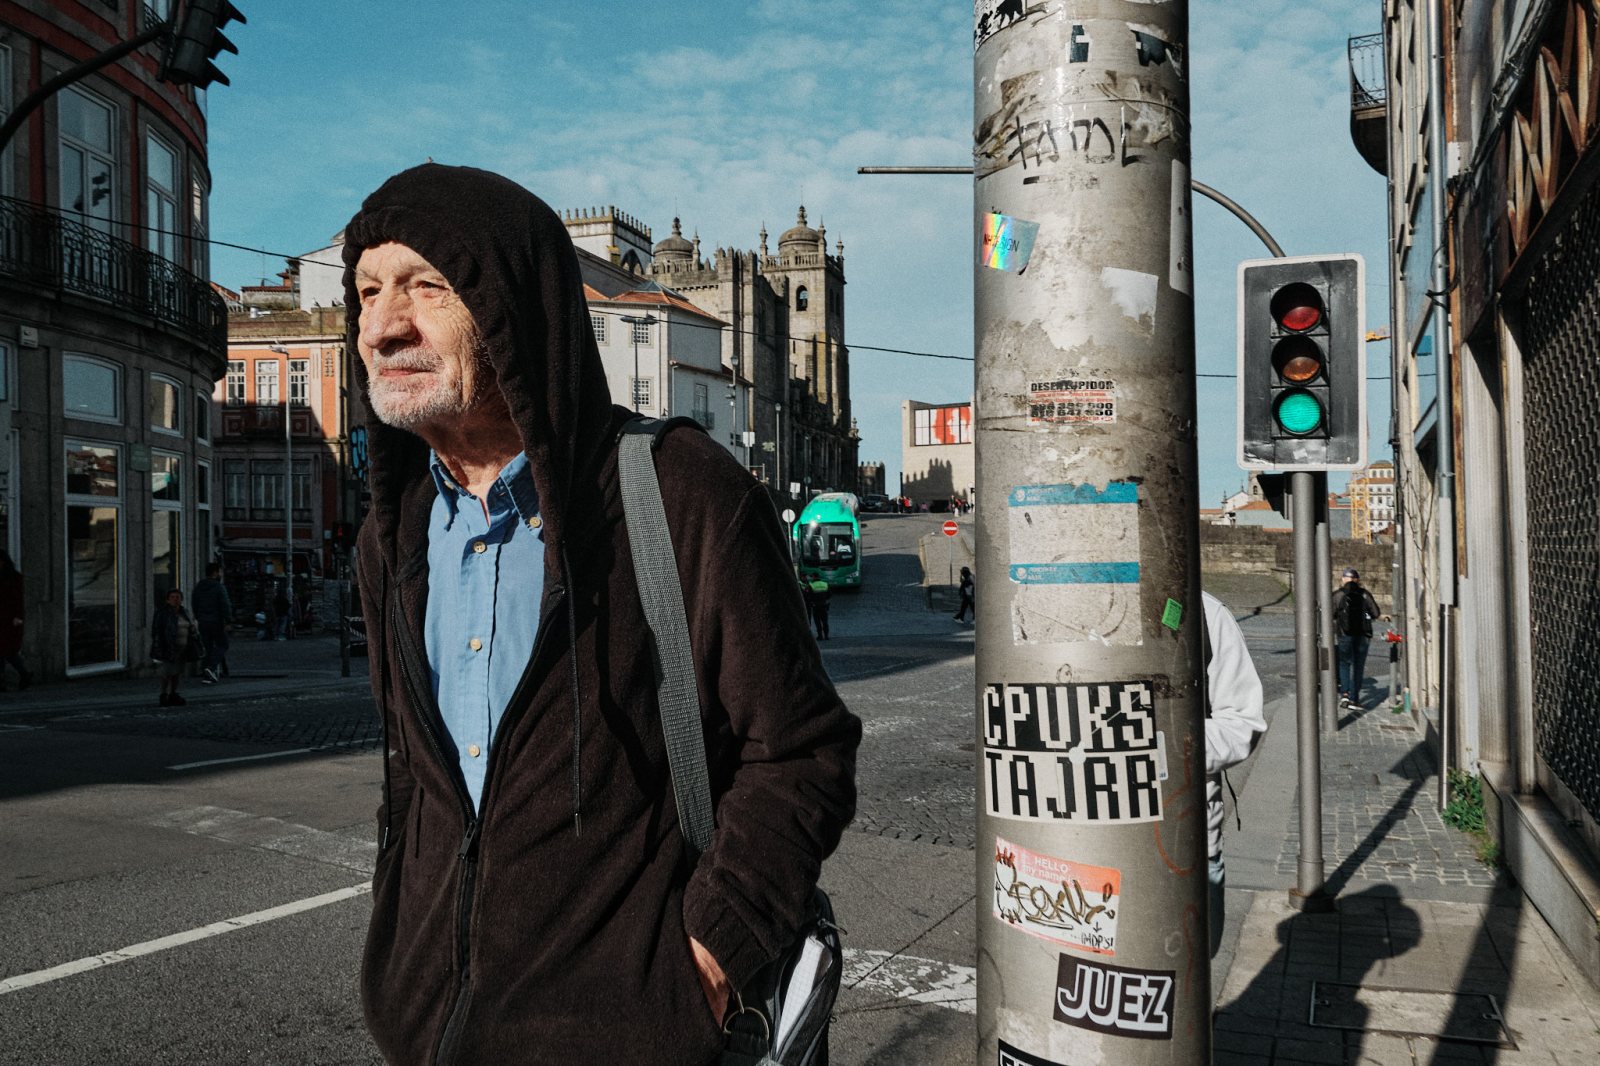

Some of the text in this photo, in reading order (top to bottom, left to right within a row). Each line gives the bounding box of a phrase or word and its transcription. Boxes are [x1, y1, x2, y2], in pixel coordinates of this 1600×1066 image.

[1031, 380, 1114, 391] DESEUPIDOR
[1023, 865, 1035, 876] my
[1039, 869, 1065, 881] name
[1034, 857, 1069, 873] HELLO
[1057, 964, 1173, 1032] JUEZ
